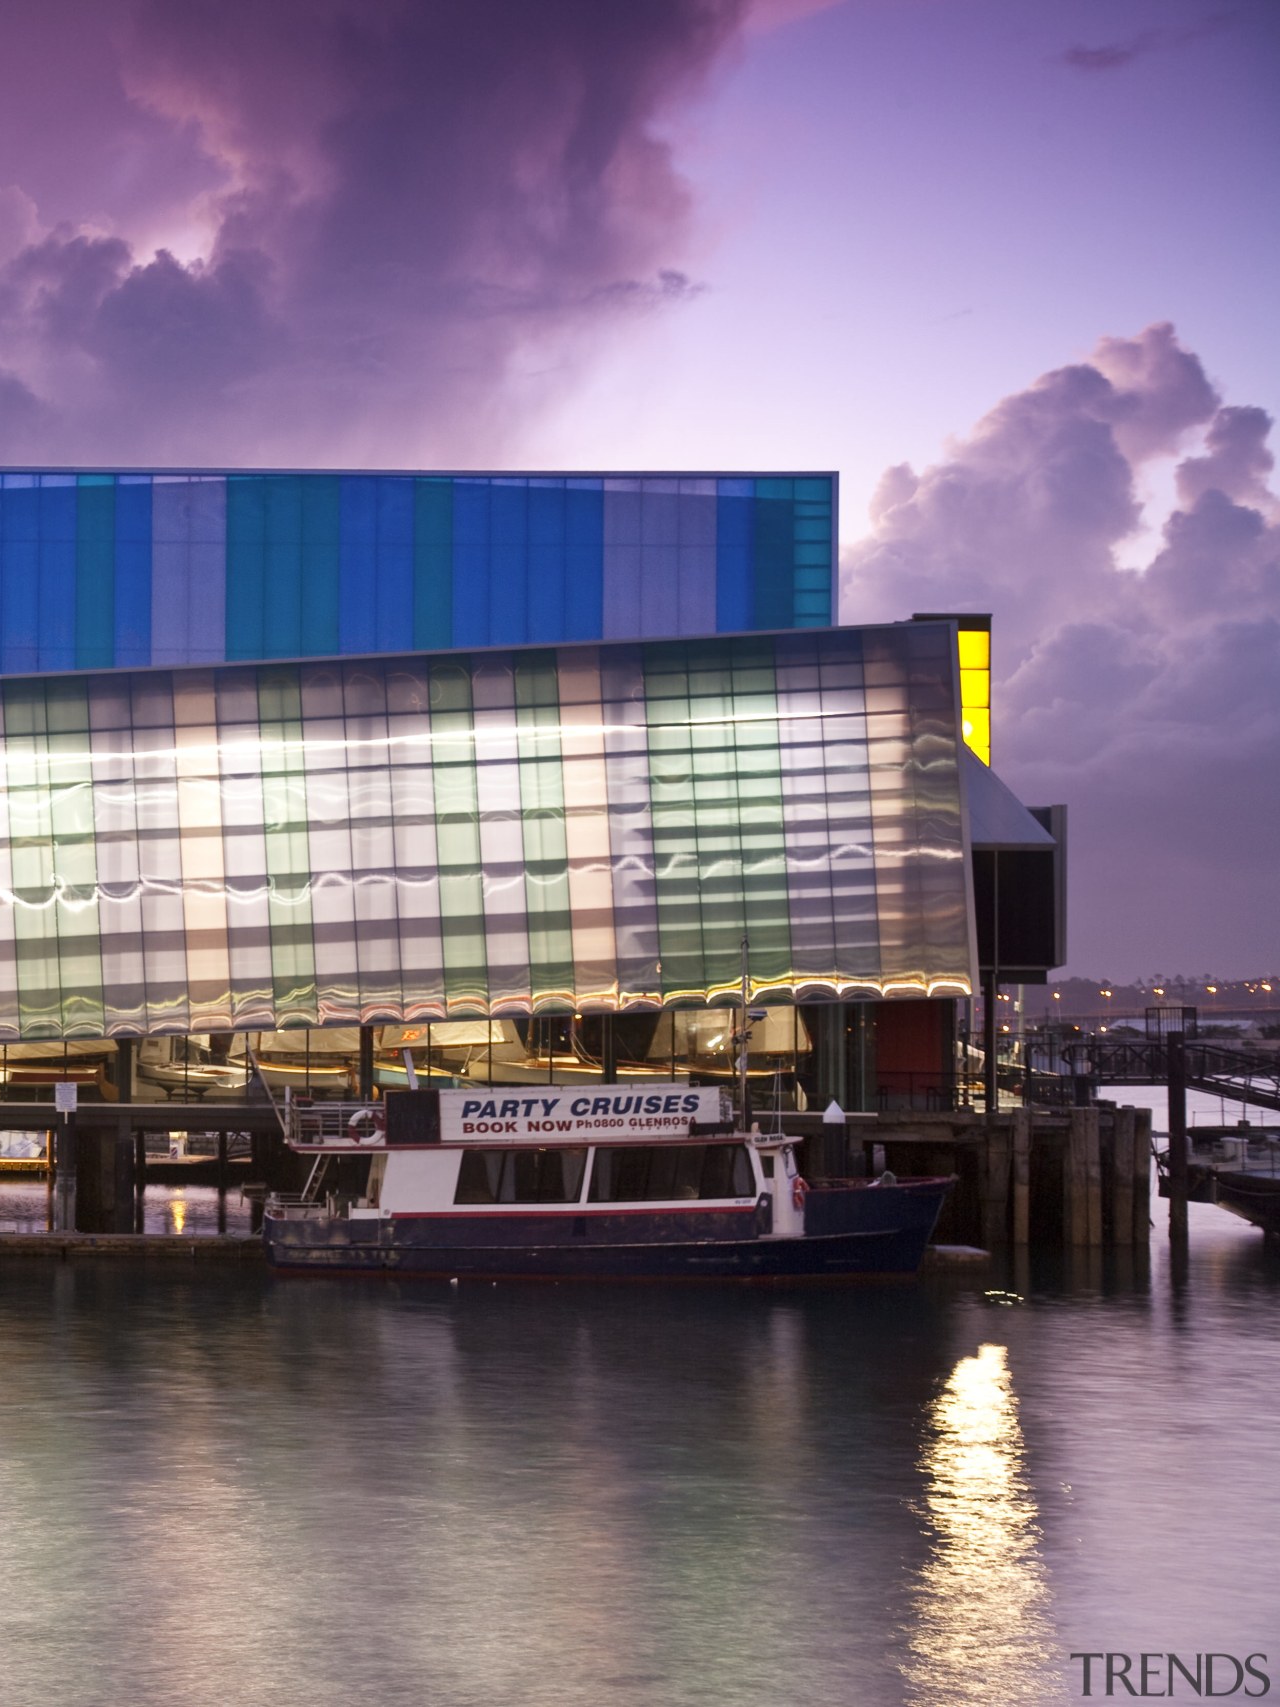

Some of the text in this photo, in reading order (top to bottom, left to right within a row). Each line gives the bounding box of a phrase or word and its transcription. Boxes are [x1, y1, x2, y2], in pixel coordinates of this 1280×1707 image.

[461, 1094, 700, 1118] PARTY CRUISES
[463, 1121, 518, 1134] BOOK
[527, 1120, 573, 1133] NOW
[629, 1115, 697, 1127] GLENROSA
